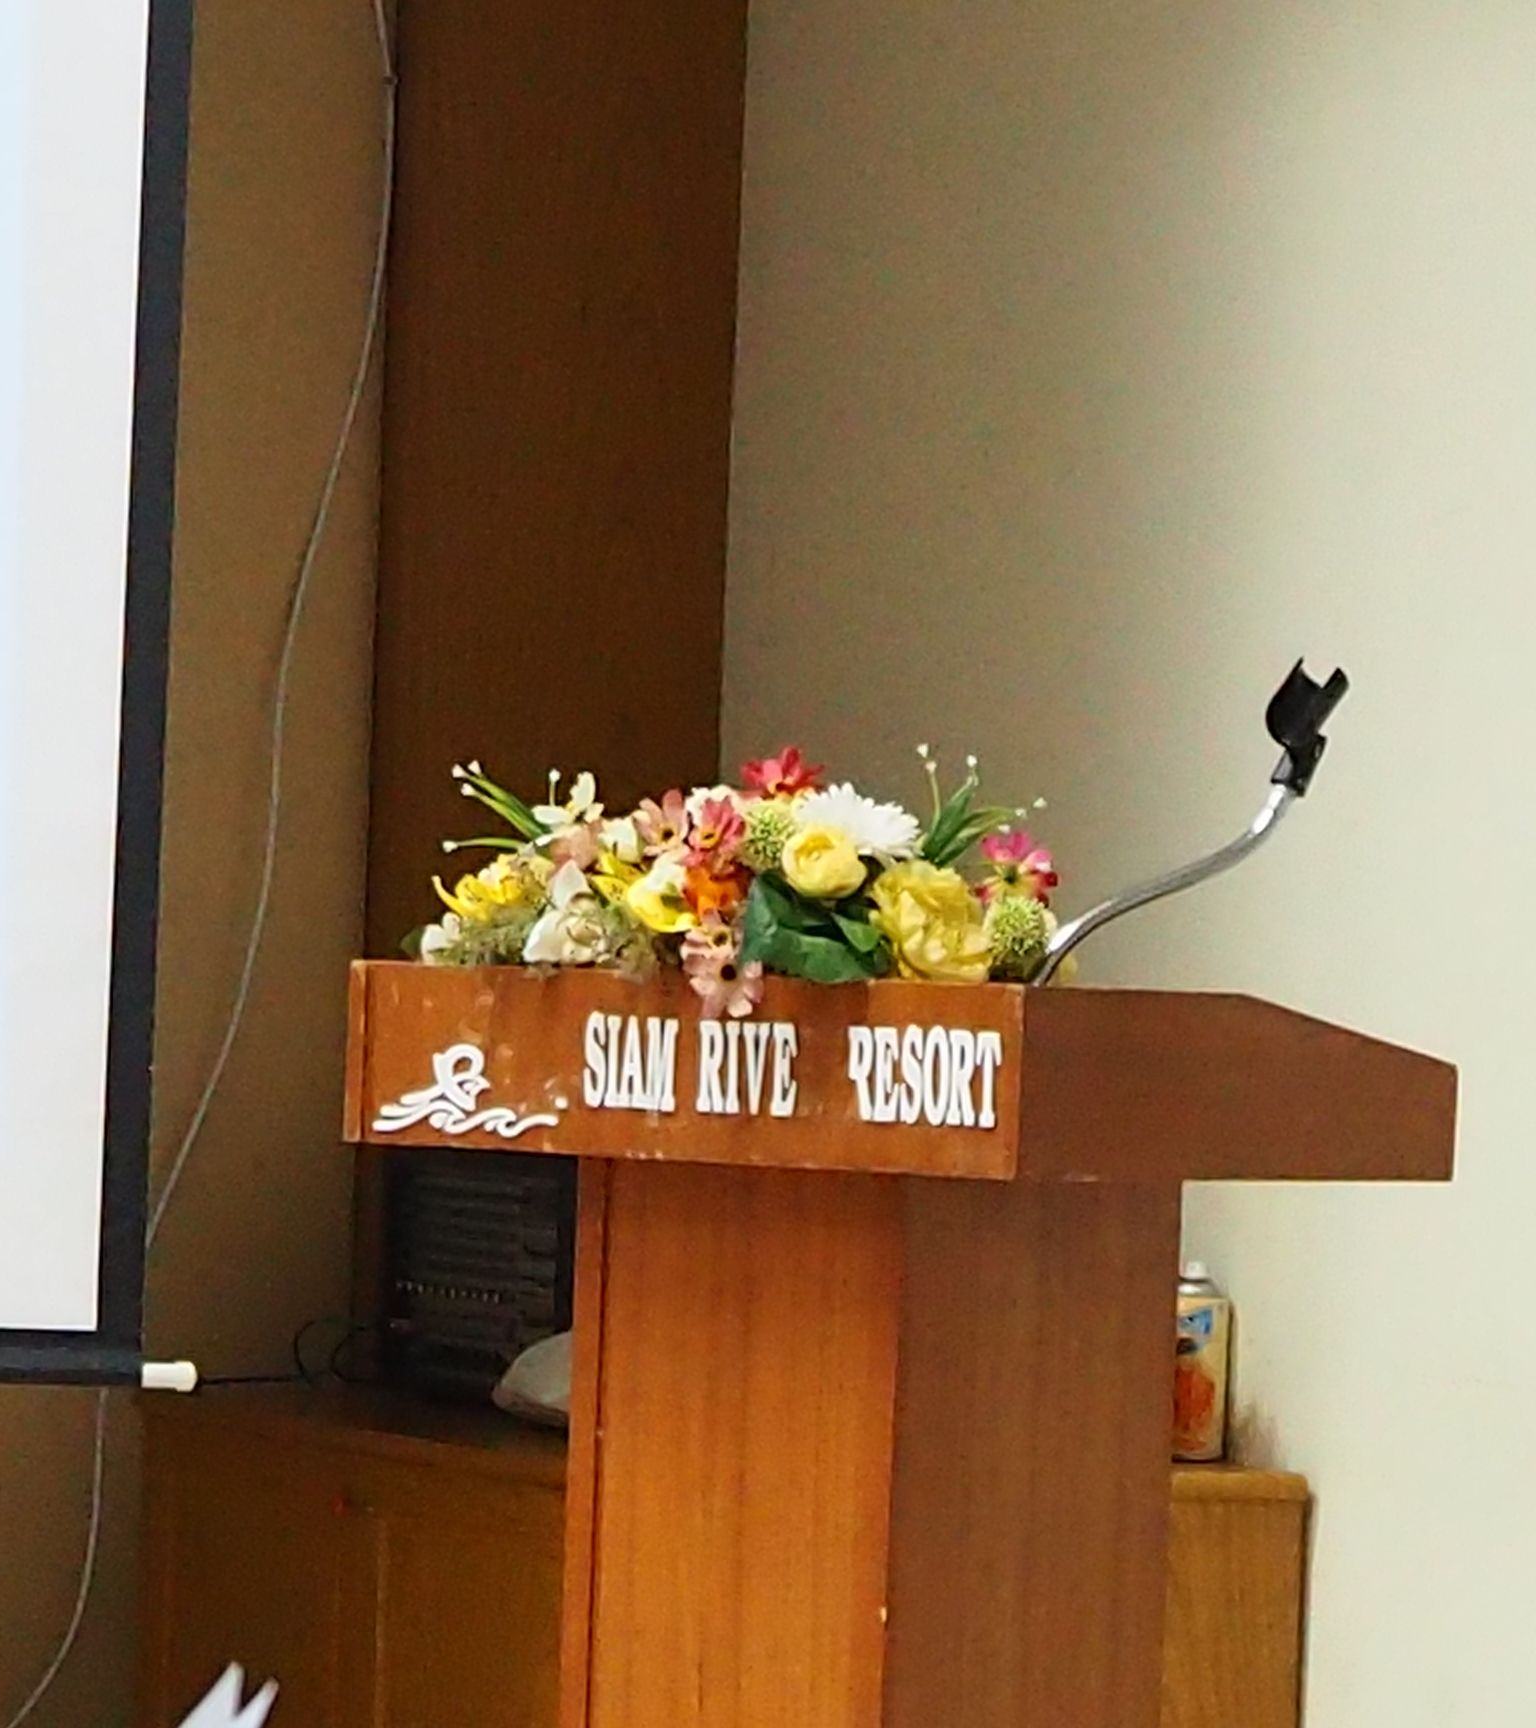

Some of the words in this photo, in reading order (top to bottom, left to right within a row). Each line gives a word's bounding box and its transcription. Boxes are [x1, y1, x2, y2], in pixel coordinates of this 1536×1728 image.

[583, 1010, 680, 1113] SIAM
[695, 1019, 798, 1118] RIVE
[847, 1024, 1002, 1129] RESORT
